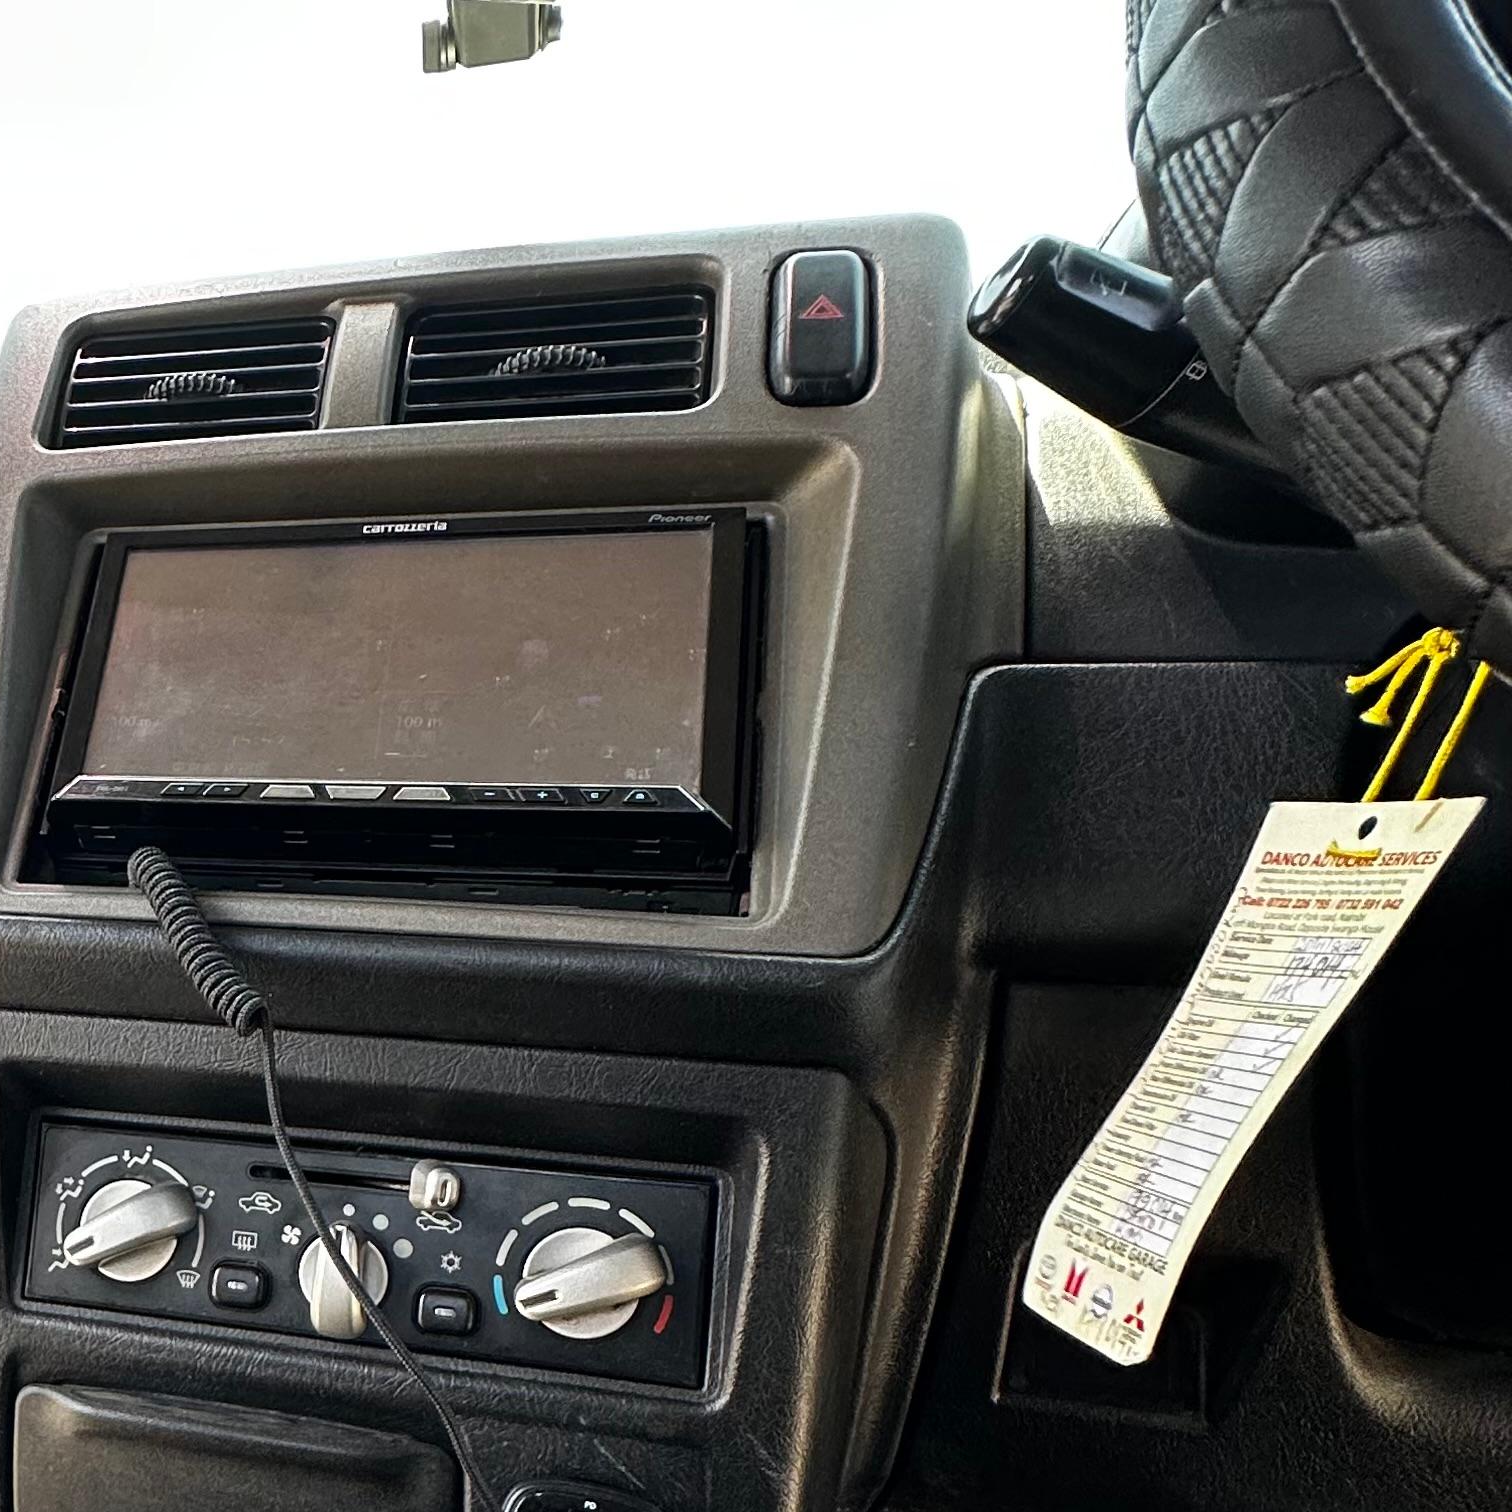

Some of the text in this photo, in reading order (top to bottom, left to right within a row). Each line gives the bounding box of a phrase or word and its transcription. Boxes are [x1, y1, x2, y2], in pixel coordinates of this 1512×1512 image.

[648, 513, 712, 524] Pioneer
[363, 520, 448, 534] carrozzeria
[1261, 851, 1310, 866] DANCO
[1378, 850, 1442, 866] SERVICES
